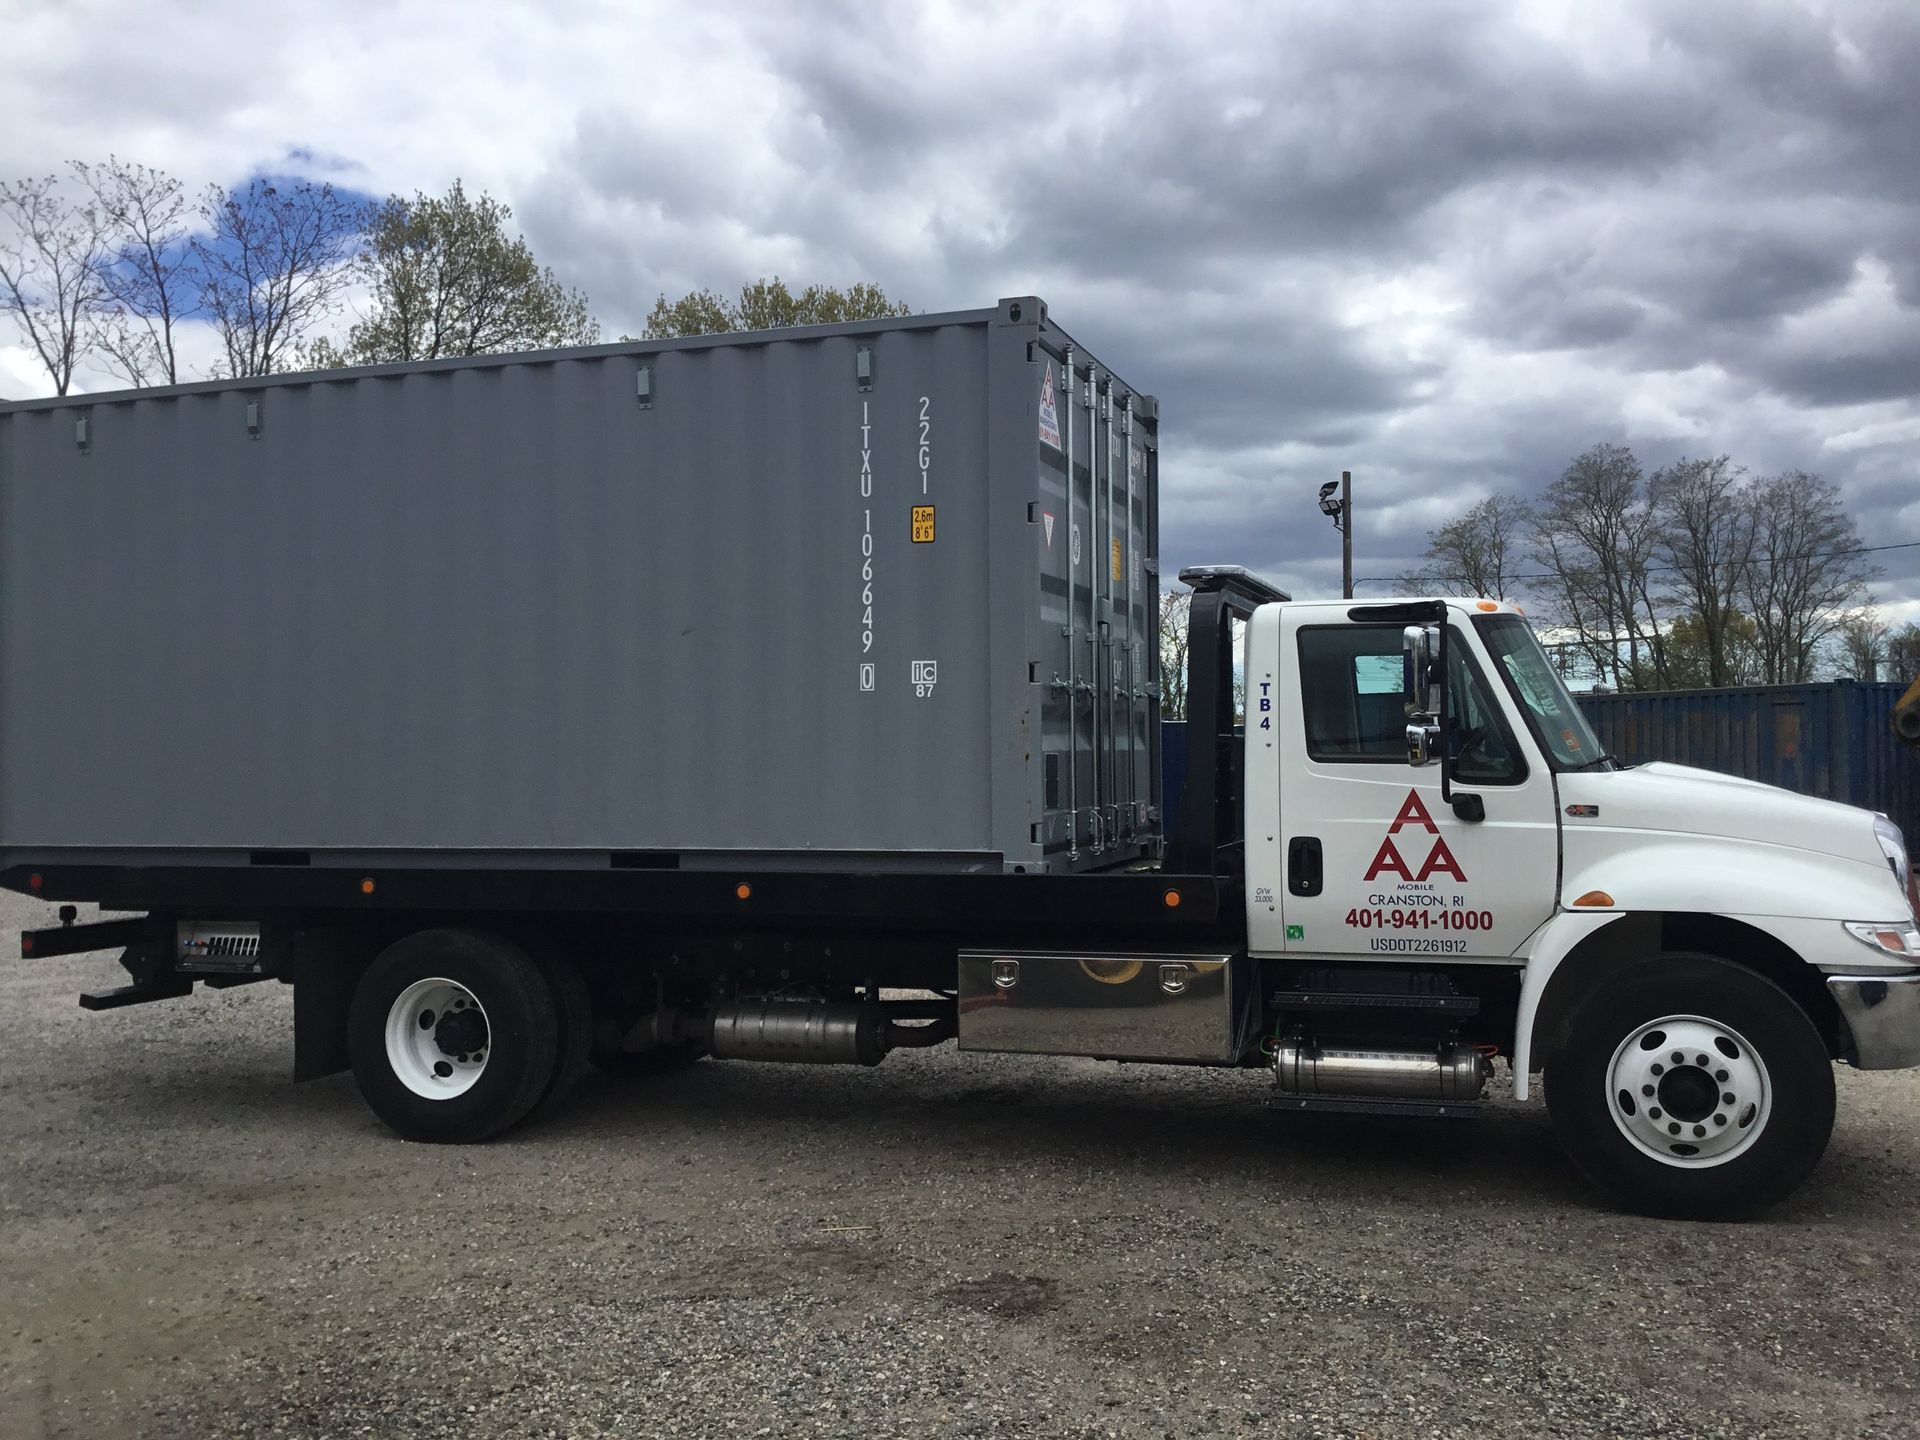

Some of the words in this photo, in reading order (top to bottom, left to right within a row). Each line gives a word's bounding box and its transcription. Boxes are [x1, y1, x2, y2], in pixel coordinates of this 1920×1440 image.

[861, 401, 872, 498] ITXU
[919, 396, 931, 495] 22G1
[861, 509, 873, 654] 106649
[915, 684, 934, 698] 87
[1256, 887, 1272, 896] GVW
[1368, 894, 1447, 908] CRANSTON,
[1453, 895, 1464, 907] RI
[1345, 908, 1493, 931] 401-941-1000
[1371, 938, 1467, 953] USDOT2261912
